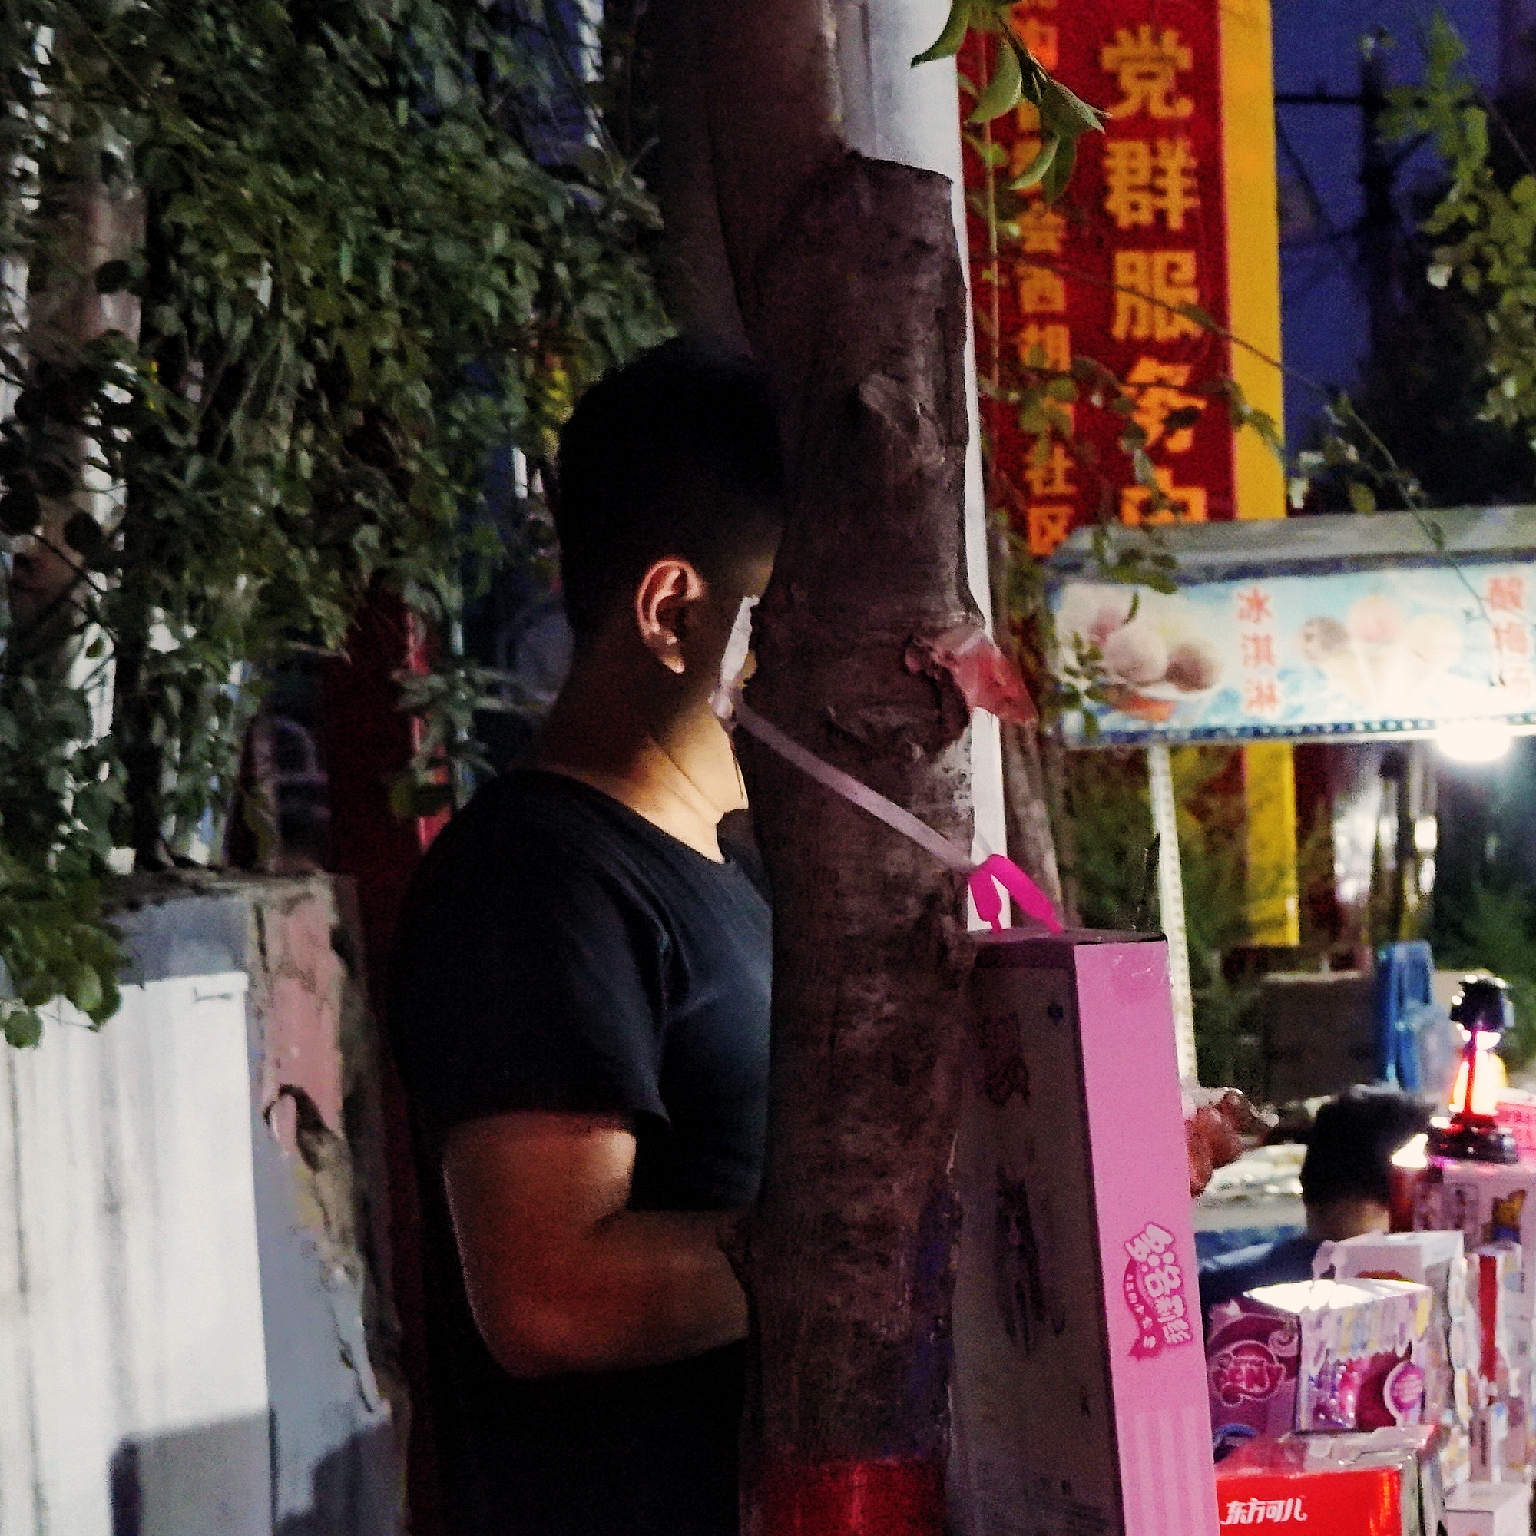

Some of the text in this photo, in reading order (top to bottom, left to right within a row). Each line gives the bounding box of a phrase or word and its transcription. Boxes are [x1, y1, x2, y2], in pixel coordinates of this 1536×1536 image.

[1236, 587, 1278, 712] 冰淇淋
[1220, 1497, 1308, 1525] 东方可儿
